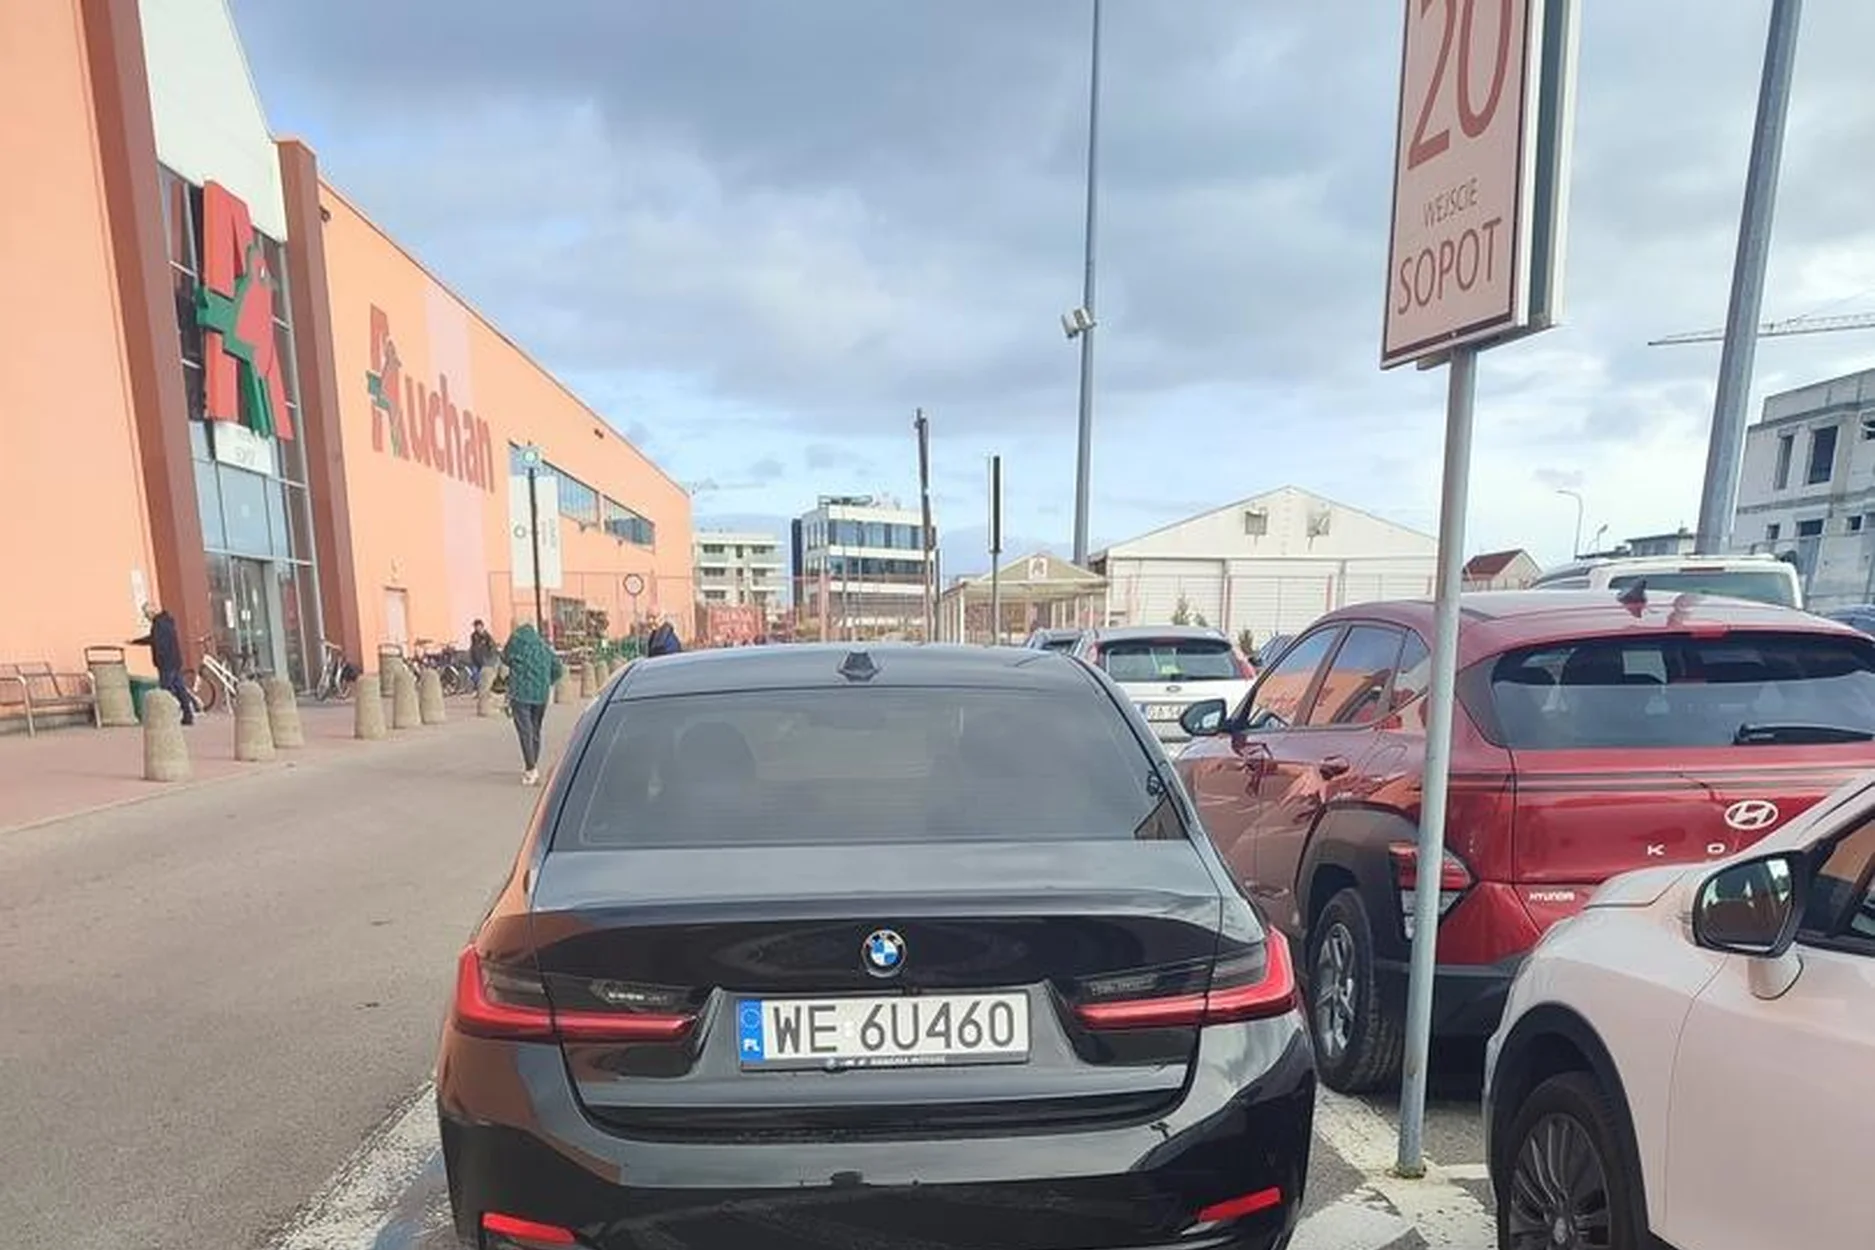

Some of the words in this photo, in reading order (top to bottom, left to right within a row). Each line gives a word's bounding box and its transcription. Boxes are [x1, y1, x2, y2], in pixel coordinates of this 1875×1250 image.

[1407, 0, 1513, 171] 20
[1397, 217, 1502, 316] SOPOT
[366, 302, 495, 493] Auchan
[773, 1004, 838, 1054] WE
[859, 1000, 1015, 1052] 6U460
